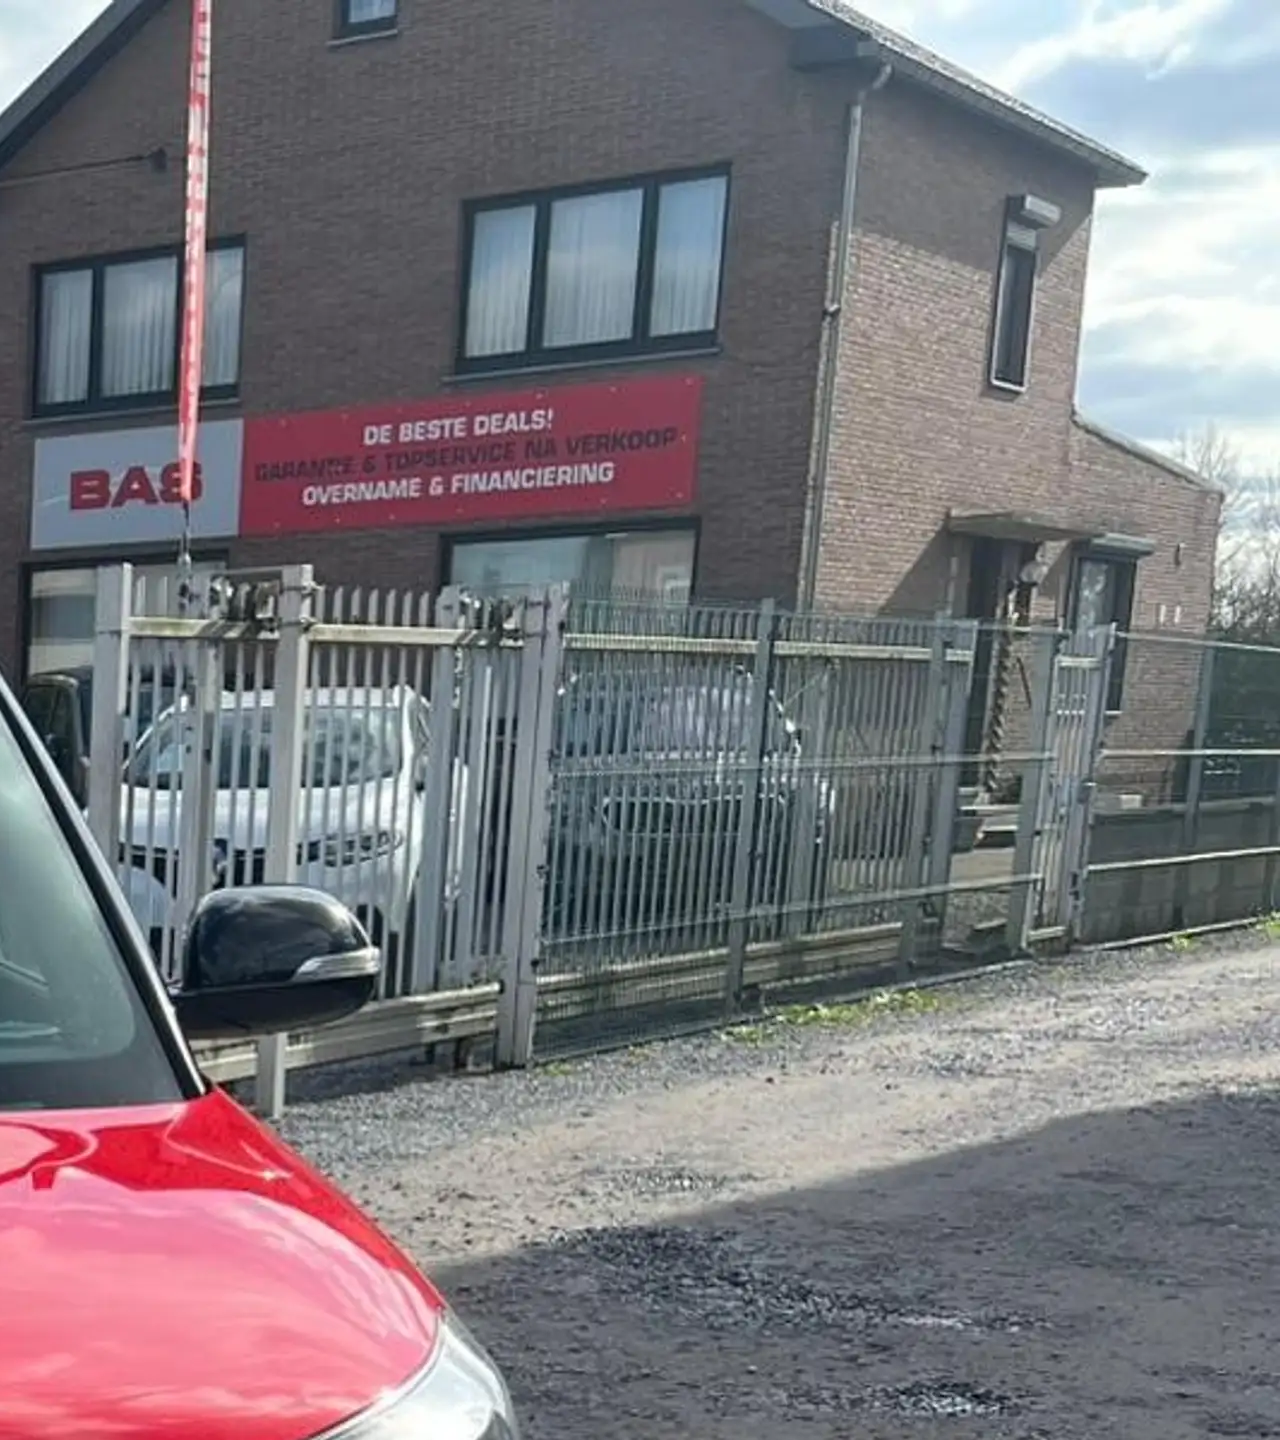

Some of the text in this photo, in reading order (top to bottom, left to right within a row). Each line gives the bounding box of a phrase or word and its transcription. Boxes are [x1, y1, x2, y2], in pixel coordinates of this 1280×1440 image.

[363, 407, 554, 446] DE BESTE DEALS!
[385, 440, 516, 470] TOPSERVICE
[524, 436, 557, 459] NA
[566, 427, 678, 455] VERKOOP
[70, 460, 203, 510] BAS
[302, 461, 615, 506] OVERNAME & FINANCIERING
